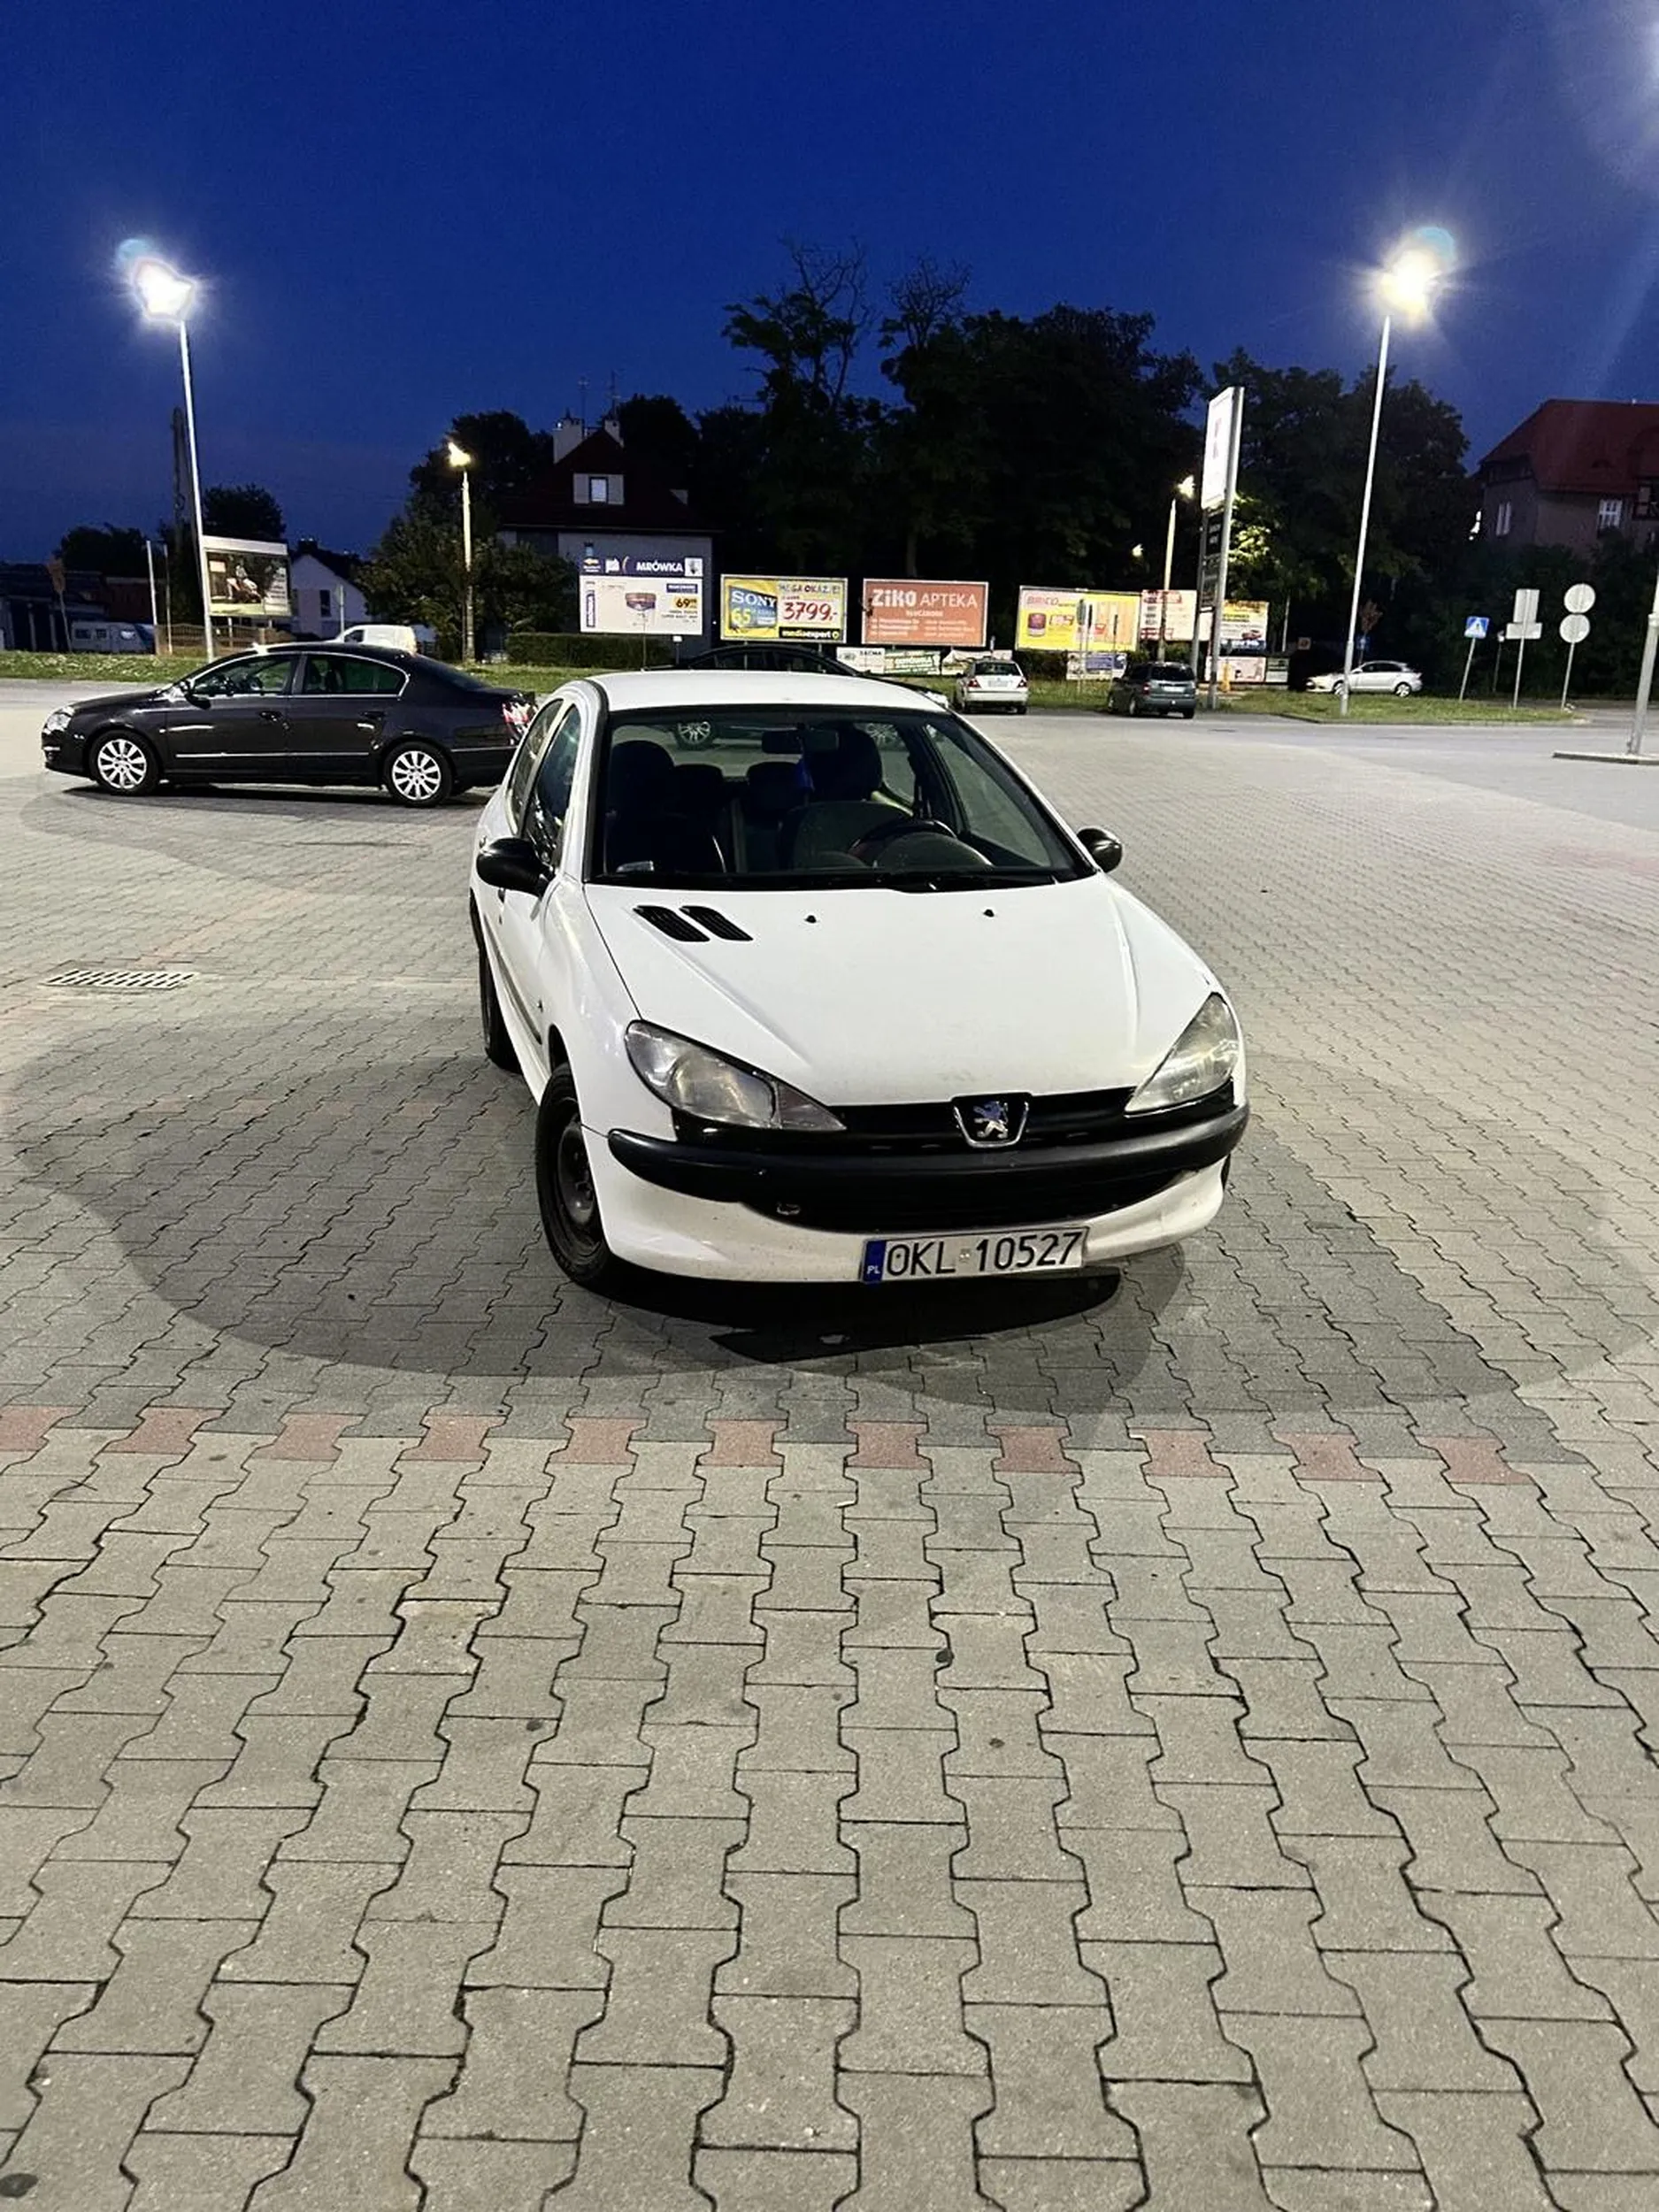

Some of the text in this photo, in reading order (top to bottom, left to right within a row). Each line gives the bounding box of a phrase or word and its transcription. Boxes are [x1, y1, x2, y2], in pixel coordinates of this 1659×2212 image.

[636, 560, 684, 572] MRÓWKA
[732, 590, 776, 609] SONY
[920, 592, 978, 609] APTEKA
[887, 1232, 1083, 1277] OKL 10527
[866, 1265, 880, 1275] PL
